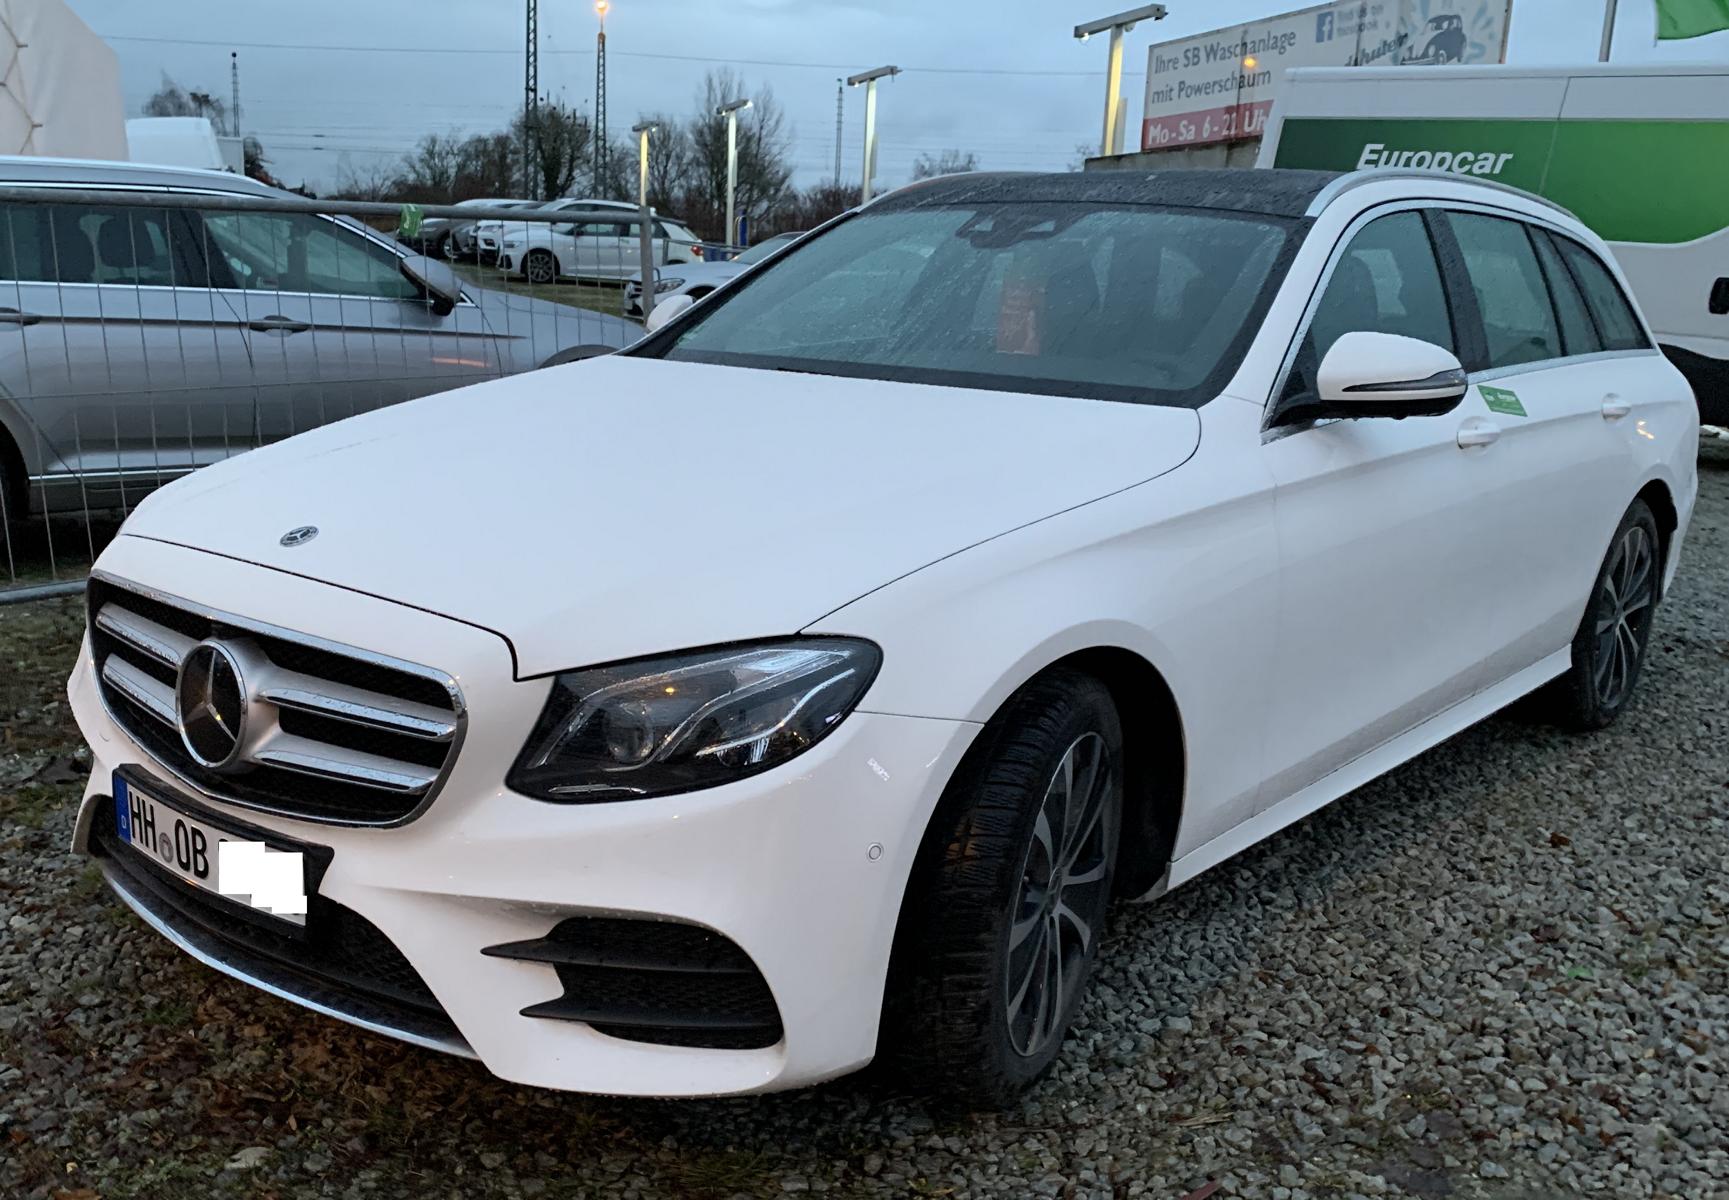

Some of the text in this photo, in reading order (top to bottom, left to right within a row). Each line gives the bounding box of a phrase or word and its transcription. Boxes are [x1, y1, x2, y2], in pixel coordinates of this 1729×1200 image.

[1155, 31, 1296, 74] Ihre SB Waschanlage
[1152, 70, 1271, 104] mit Powerschaum
[1243, 109, 1269, 133] Uh
[1356, 143, 1514, 175] Europcar
[129, 791, 158, 854] HH
[174, 818, 210, 880] OB
